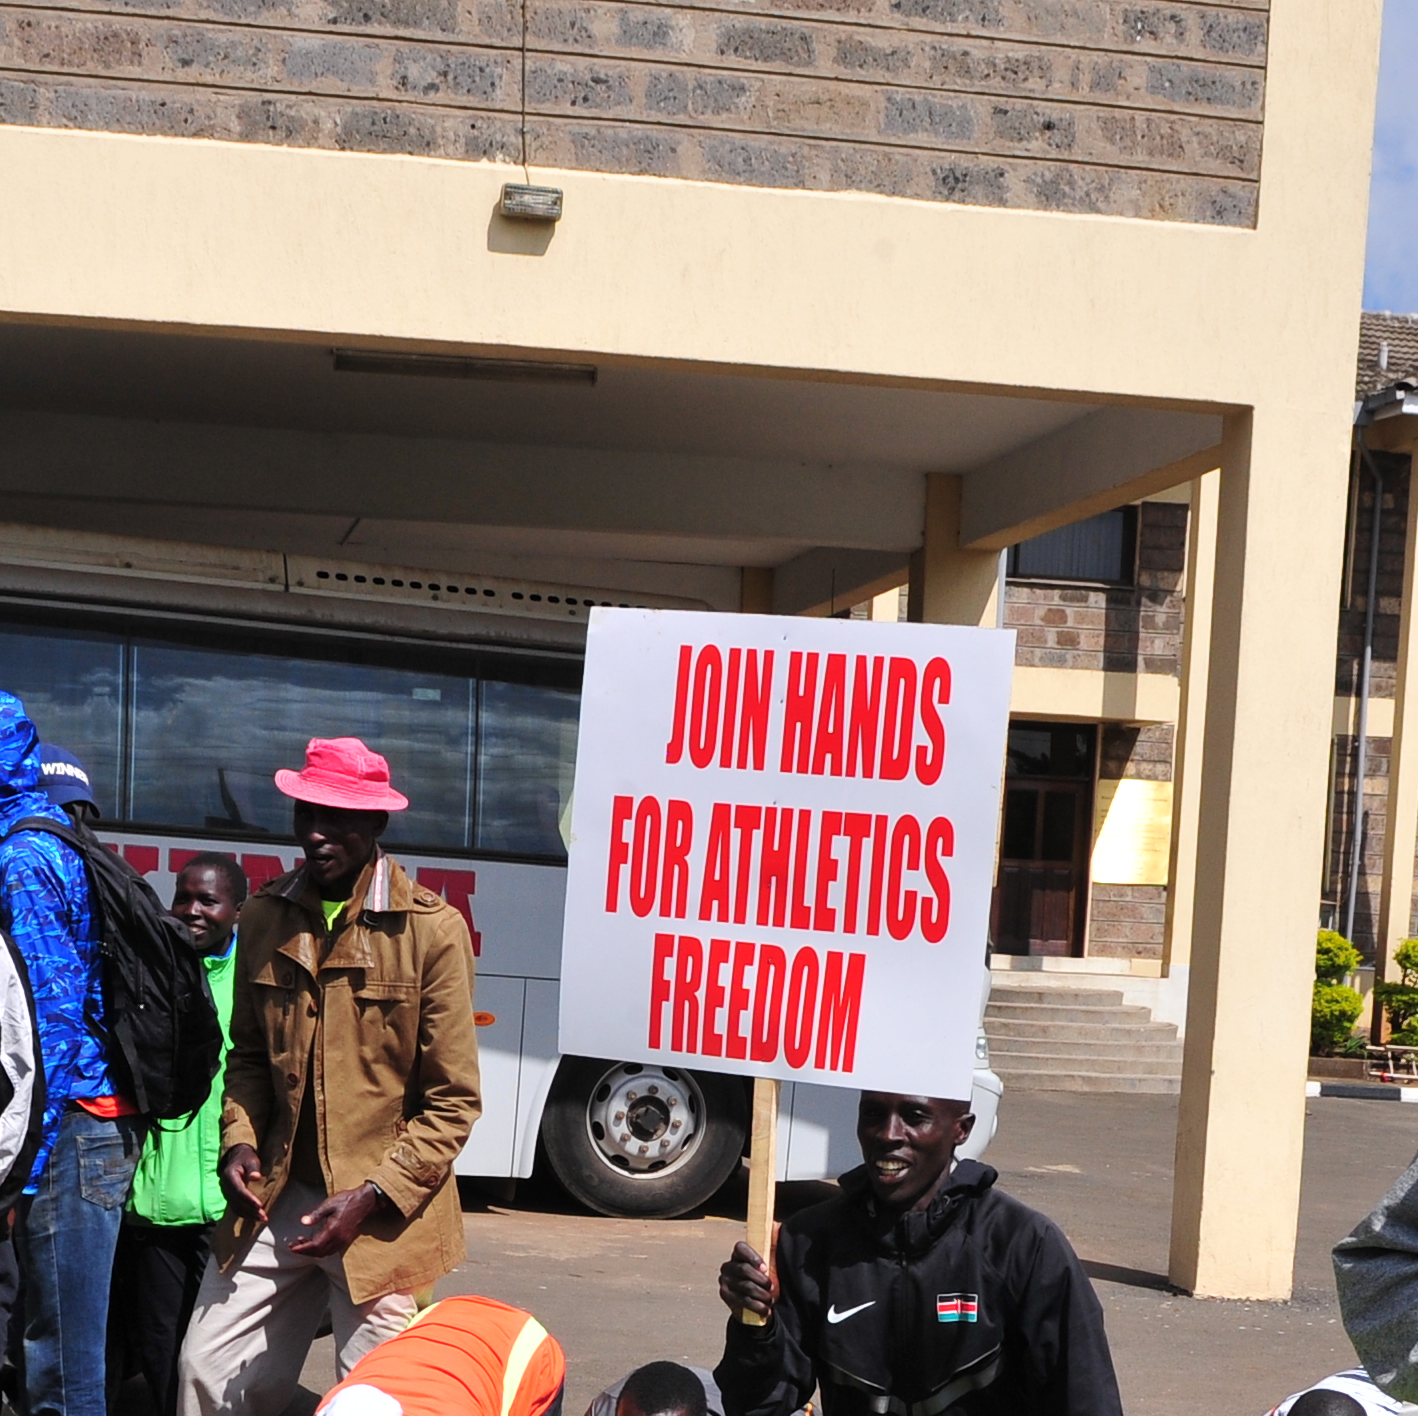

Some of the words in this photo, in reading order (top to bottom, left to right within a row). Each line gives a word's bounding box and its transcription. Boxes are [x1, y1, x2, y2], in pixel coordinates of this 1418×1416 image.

[665, 644, 775, 772] JOIN
[779, 651, 952, 787] HANDS
[605, 795, 694, 919] FOR
[698, 802, 955, 944] ATHLETICS
[648, 932, 866, 1073] FREEDOM
